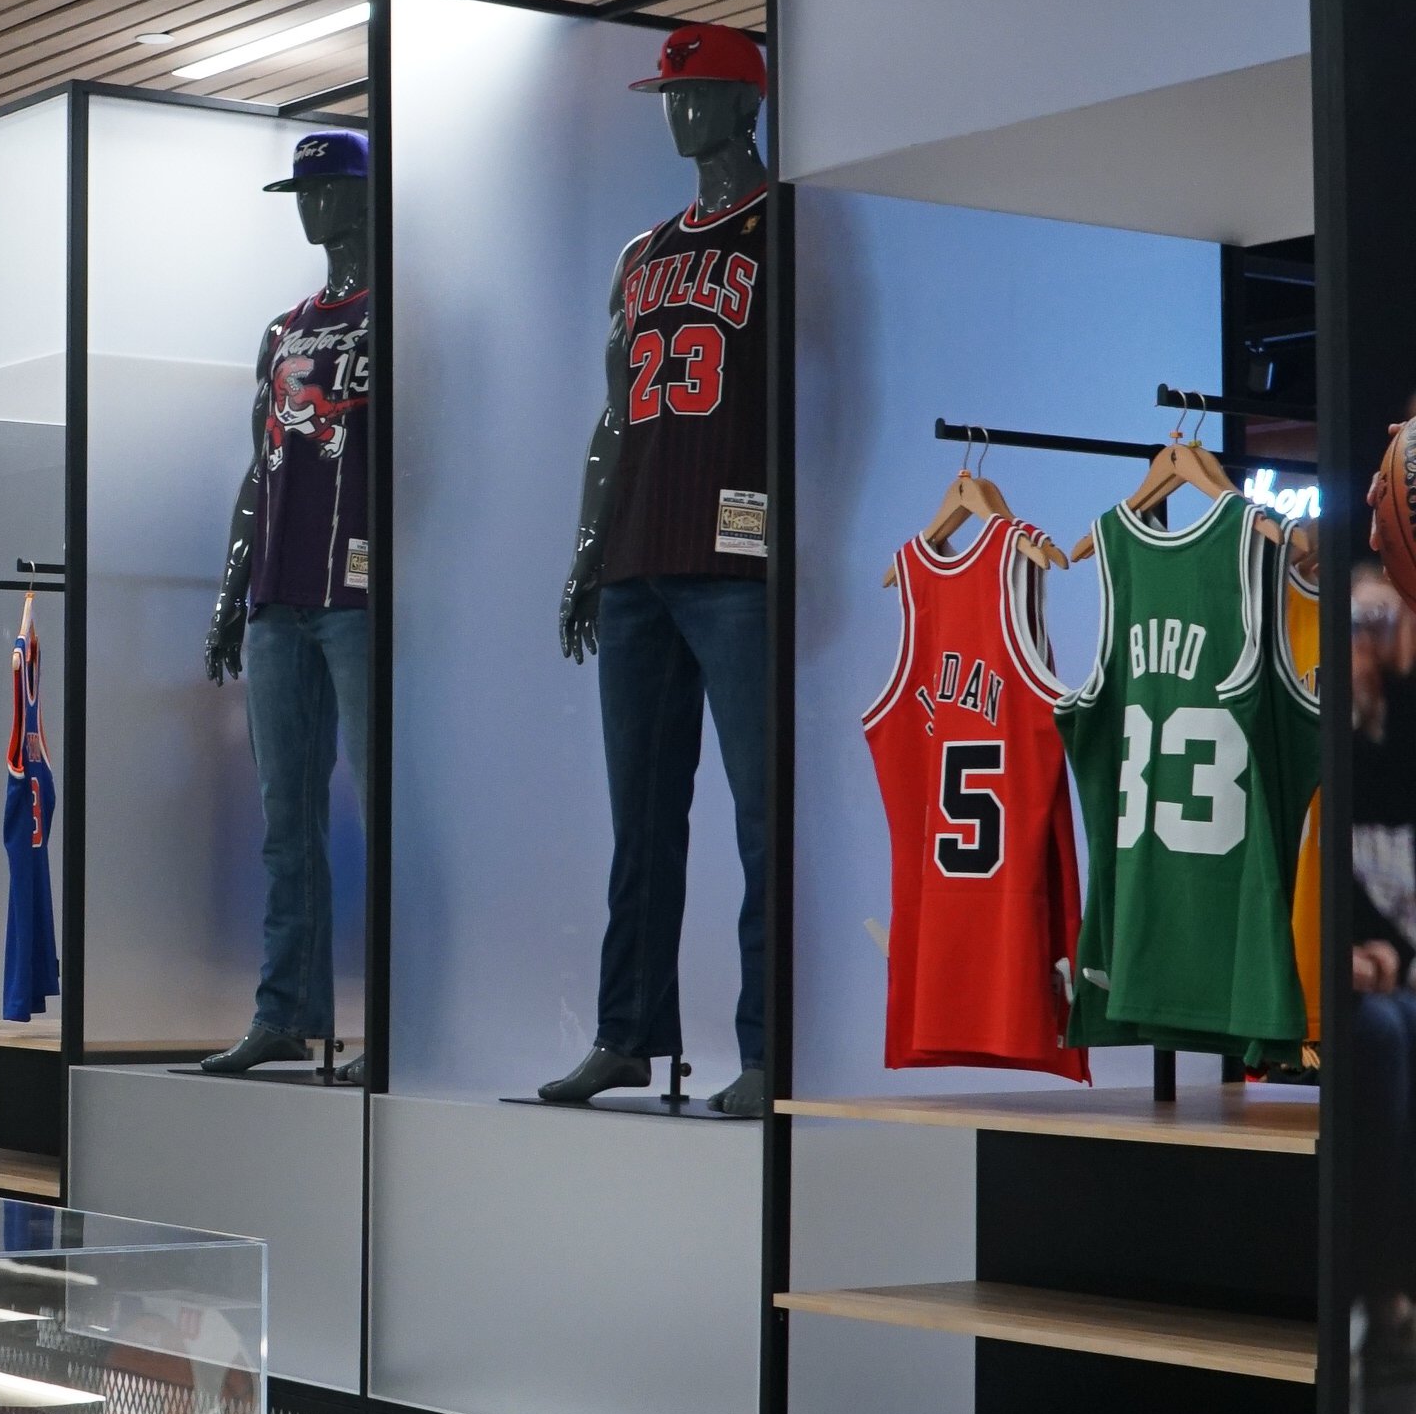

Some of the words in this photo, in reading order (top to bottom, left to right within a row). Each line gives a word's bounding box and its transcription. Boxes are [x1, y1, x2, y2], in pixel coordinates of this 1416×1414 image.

[625, 250, 758, 340] BULLS
[332, 353, 369, 392] 15
[630, 324, 725, 425] 23
[1130, 618, 1206, 681] BIRD
